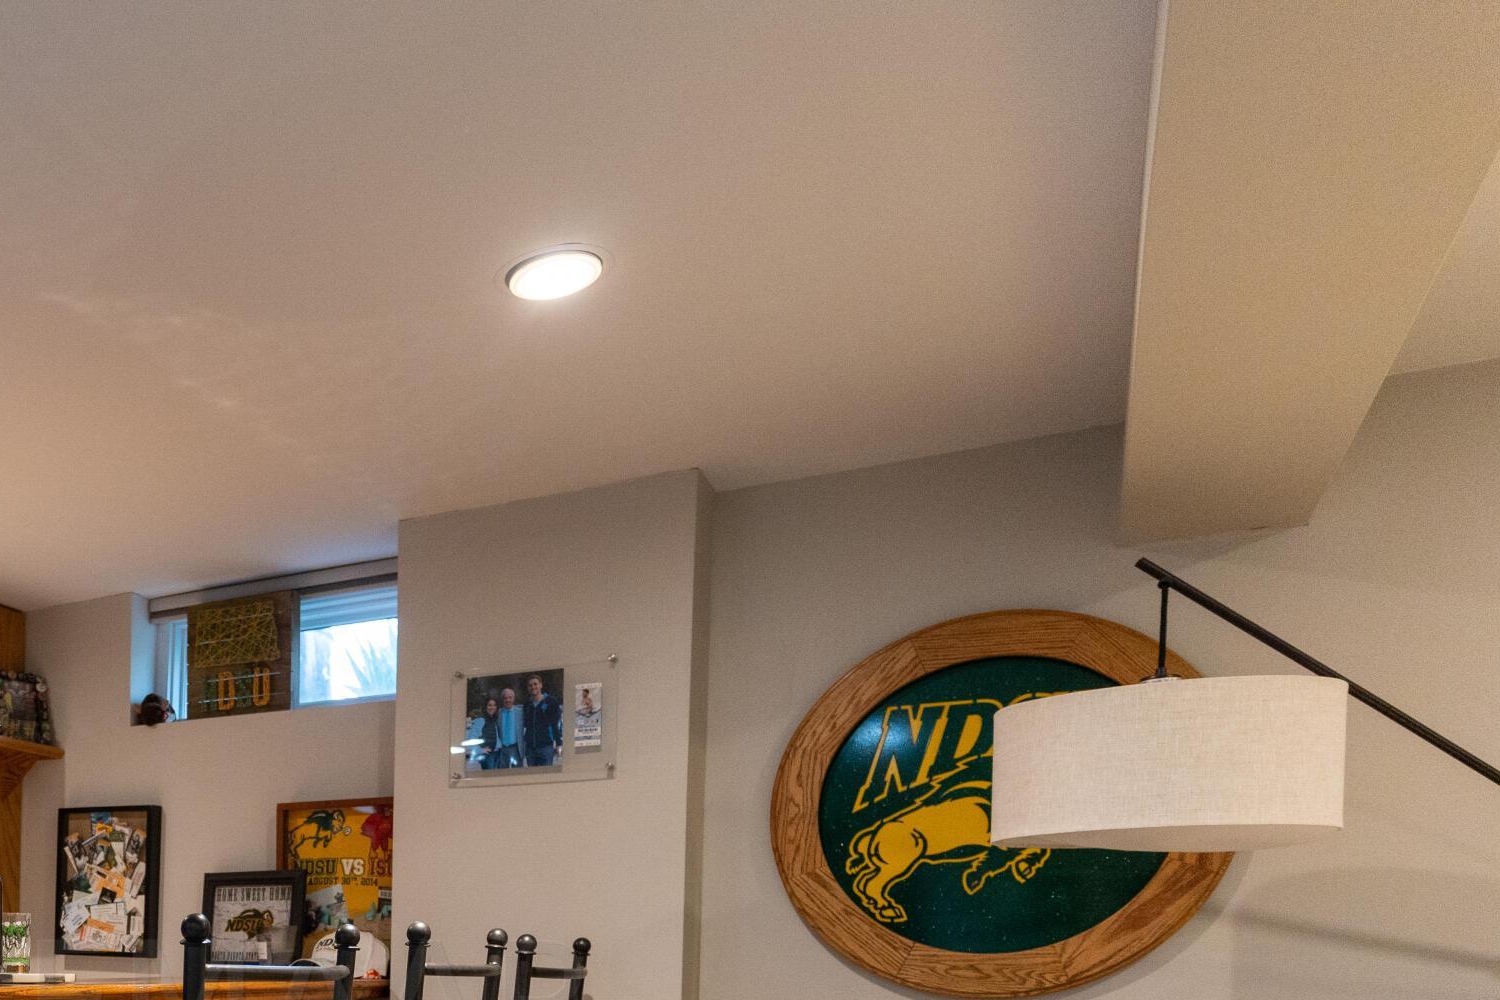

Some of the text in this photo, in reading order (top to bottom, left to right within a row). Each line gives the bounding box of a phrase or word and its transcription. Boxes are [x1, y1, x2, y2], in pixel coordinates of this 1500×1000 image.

[341, 858, 365, 876] VS
[308, 877, 338, 886] AUGUST
[361, 877, 378, 886] 2014
[216, 886, 292, 902] HOME SWEET HOME
[225, 918, 261, 933] NDSU
